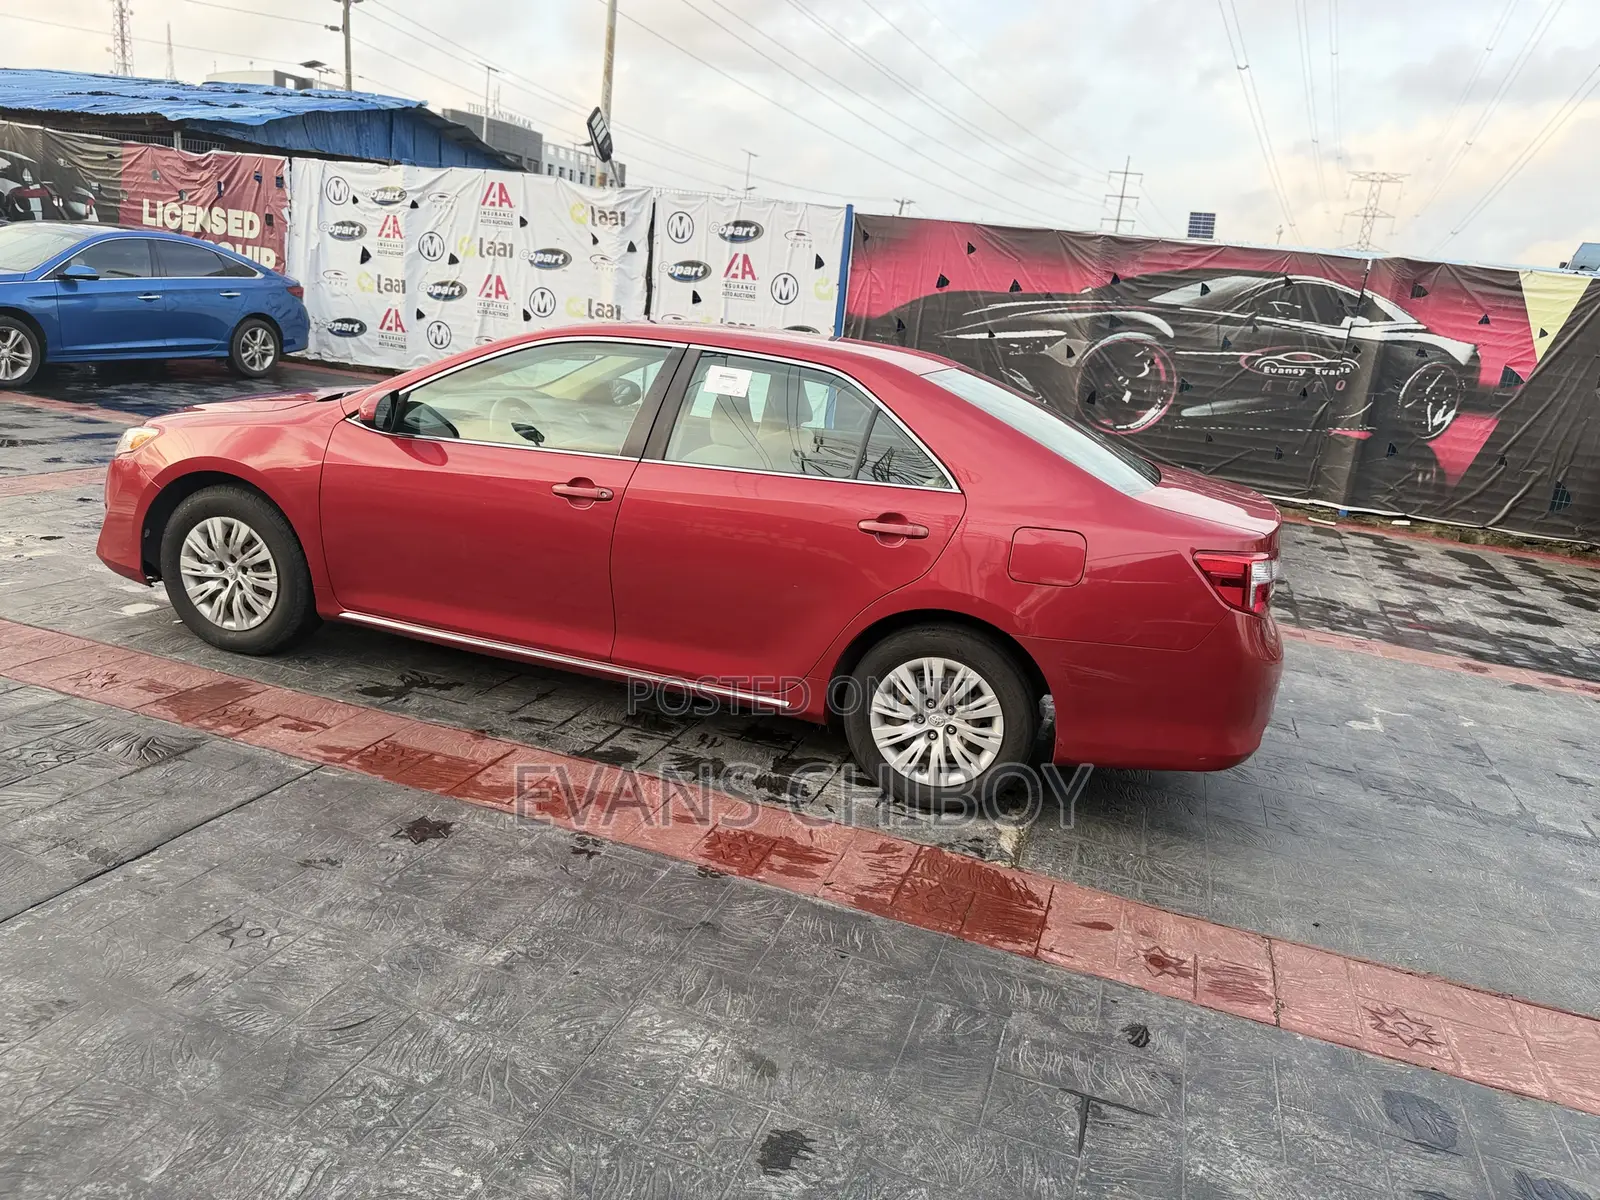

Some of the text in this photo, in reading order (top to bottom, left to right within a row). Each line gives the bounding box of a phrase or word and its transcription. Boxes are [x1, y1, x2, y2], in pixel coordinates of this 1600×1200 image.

[143, 199, 260, 239] LICENSED
[320, 221, 361, 238] Copart
[709, 221, 757, 238] Copart
[520, 249, 565, 265] Copart
[658, 261, 705, 277] Copart
[418, 281, 461, 297] Copart
[723, 282, 756, 291] INSURANCE
[1264, 366, 1350, 376] Evansy Evans
